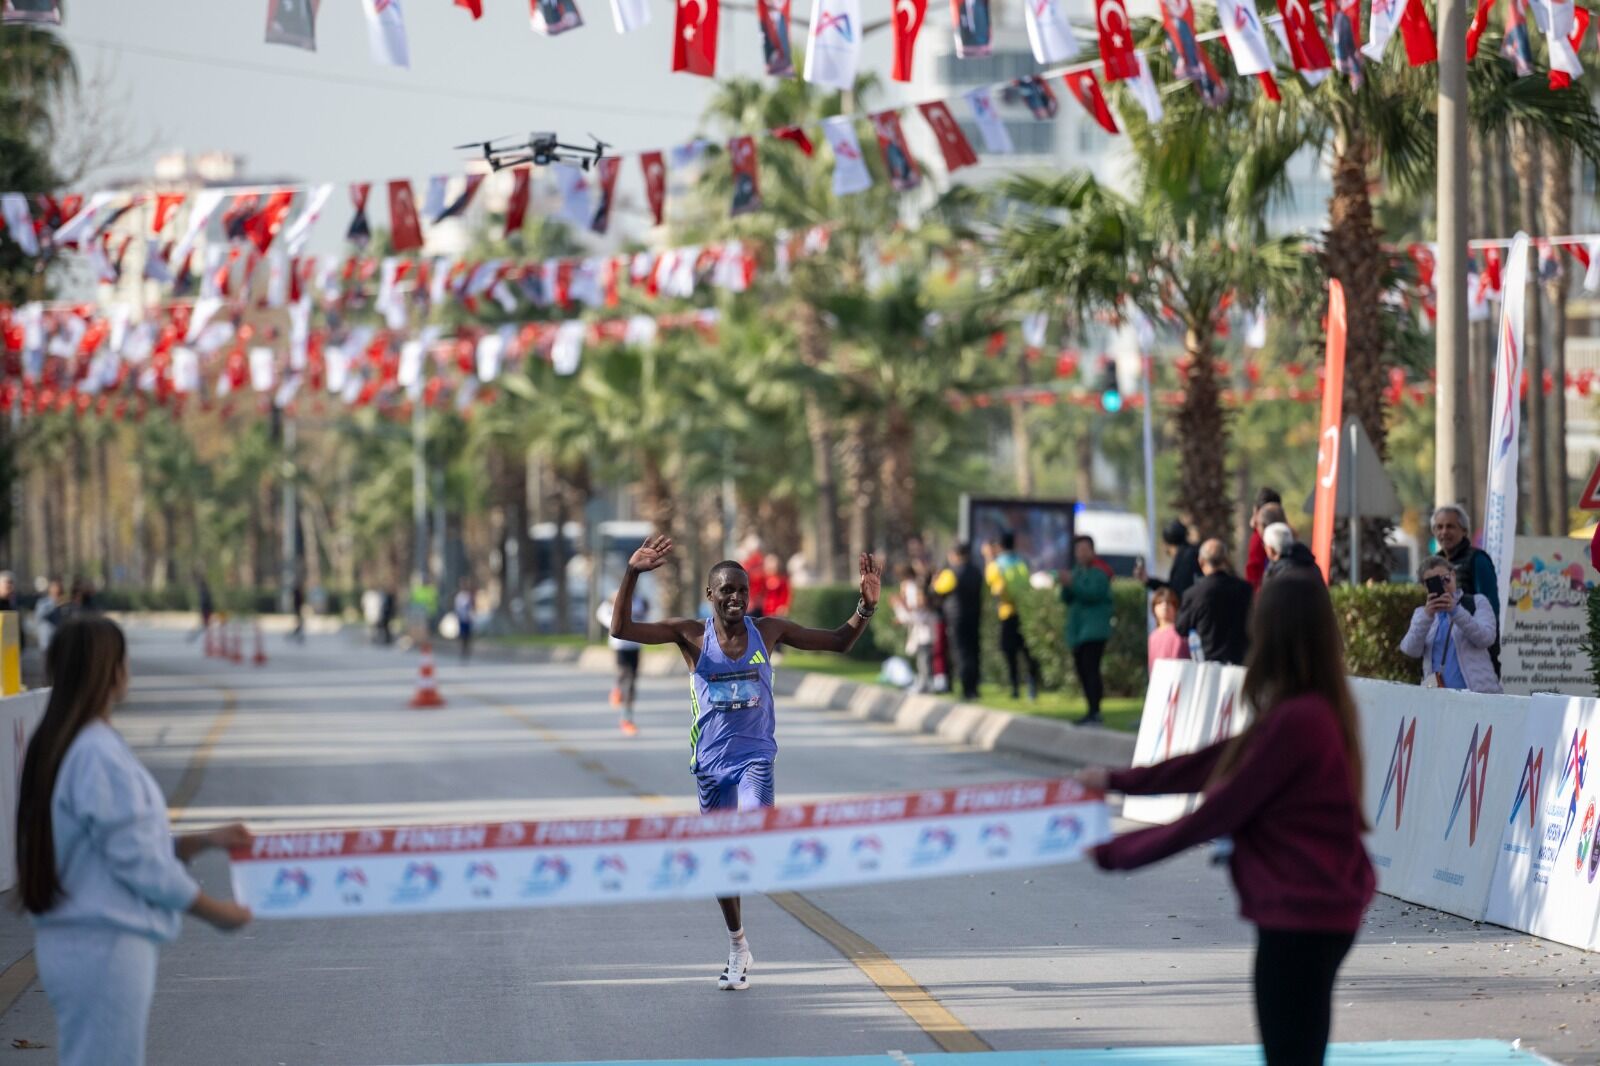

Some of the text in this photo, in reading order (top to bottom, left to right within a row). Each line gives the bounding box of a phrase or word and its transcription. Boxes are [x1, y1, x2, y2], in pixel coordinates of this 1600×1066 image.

[1515, 620, 1580, 631] Mersin'imizin
[1502, 632, 1553, 647] güzelliğine
[1518, 647, 1576, 658] katmak için
[1521, 660, 1573, 671] bu alanda
[732, 683, 740, 700] 2
[252, 784, 1047, 858] FINISH FINISH FINISH FINISH FINISH FINISH
